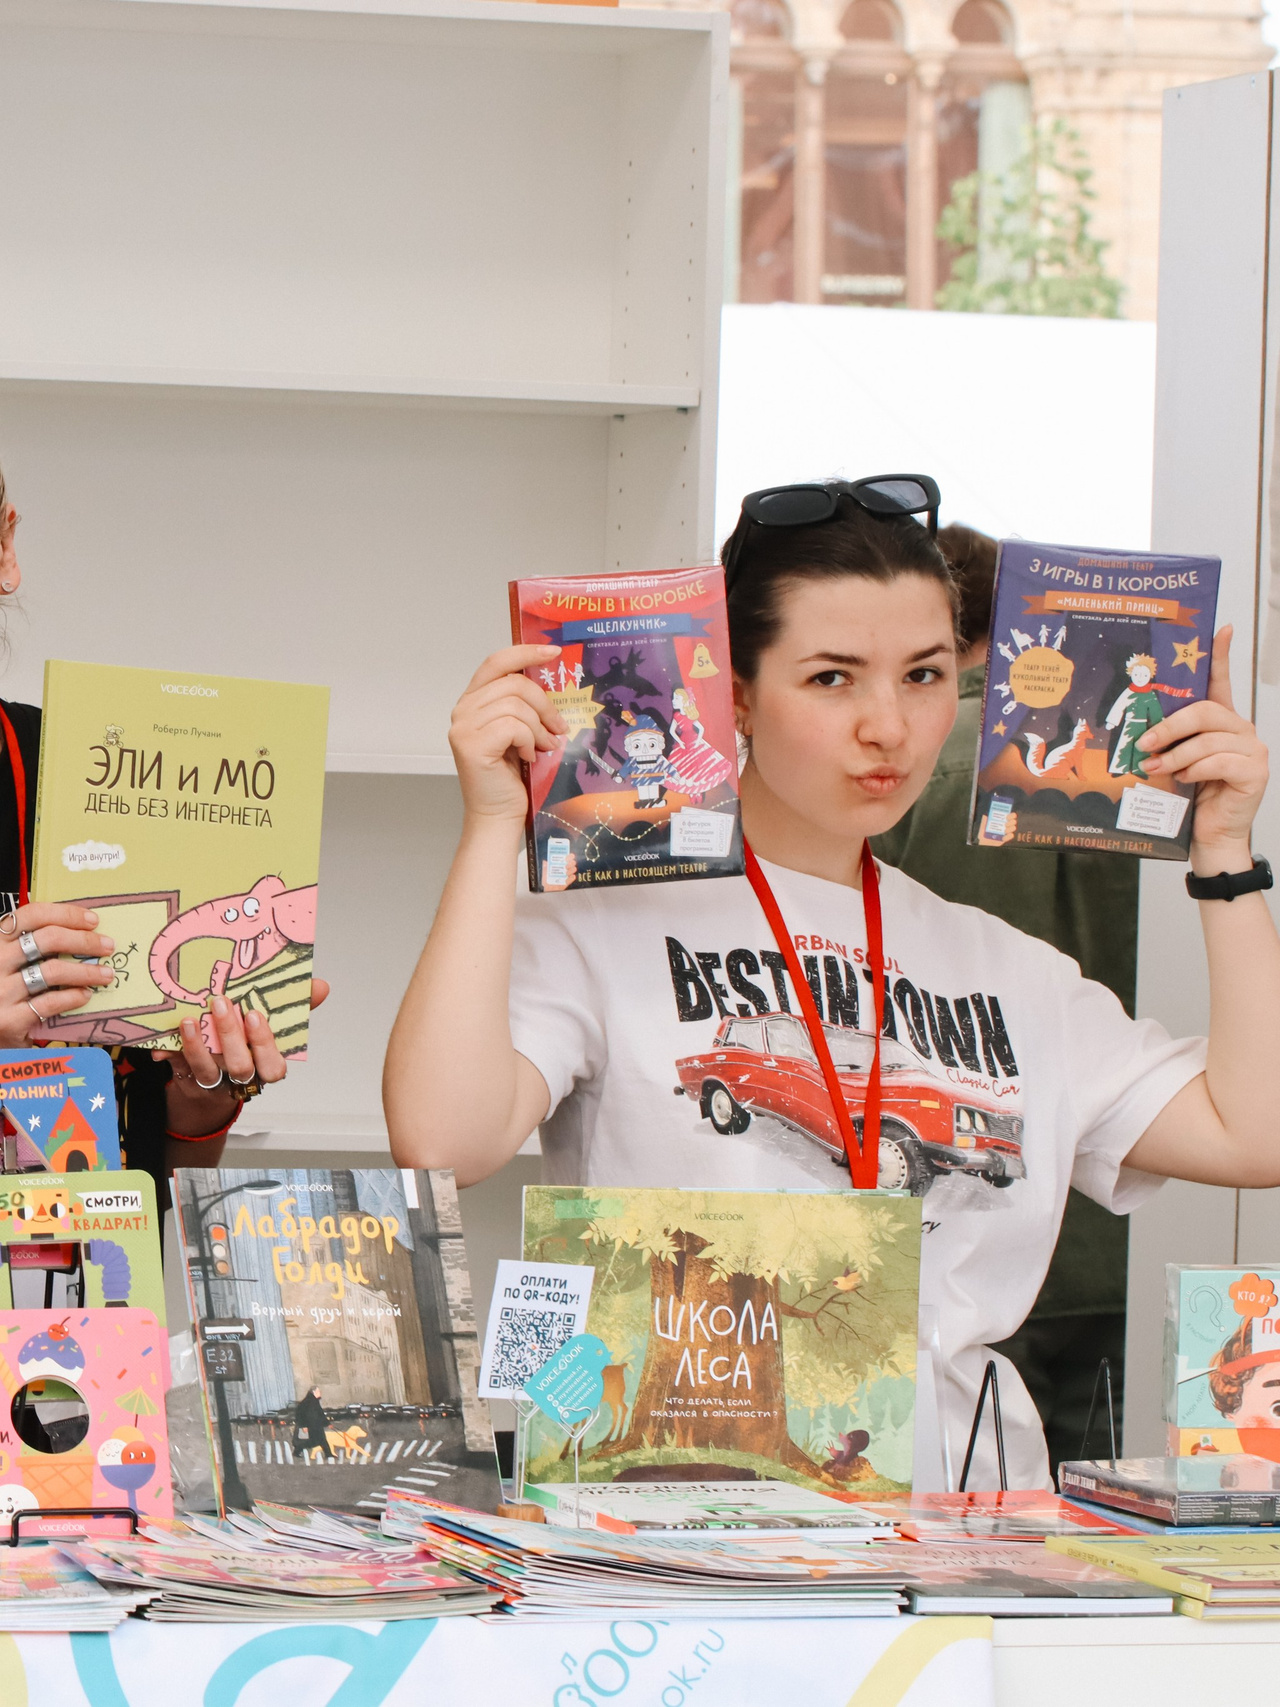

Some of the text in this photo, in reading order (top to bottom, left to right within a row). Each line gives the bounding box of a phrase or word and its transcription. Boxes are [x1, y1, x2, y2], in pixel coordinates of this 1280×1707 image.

[1077, 557, 1154, 571] ДОМАШНИЙ ТЕАТР
[1029, 558, 1200, 592] 3 ИГРЫ В 1 КОРОБКЕ
[586, 577, 661, 592] ДОМАШНИЙ ТЕАТР
[543, 580, 707, 612] 3 ИГРЫ В КОРОБКЕ
[1057, 594, 1164, 615] «МАЛЕНЬКИЙ ПРИНЦ»
[586, 618, 668, 634] «ЩЕЛКУНЧИК»
[587, 638, 648, 648] спектакль для всей
[697, 656, 711, 668] 5+
[1182, 648, 1194, 660] 5+
[1012, 673, 1051, 683] КУКОЛЬНЫЙ
[160, 683, 219, 698] VOICEBOOK
[1023, 684, 1055, 693] РАСКРАСКА
[153, 724, 222, 740] Роберто Лучани
[85, 745, 275, 801] ЭЛИ МО
[84, 793, 272, 828] ДЕНЬ БЕЗ ИНТЕРНЕТА
[1017, 832, 1154, 852] ВСЁ КАК НАСТОЯЩЕМ ТЕАТРЕ
[68, 850, 120, 863] Игра внутри!
[578, 863, 707, 883] ВСЁ КАК НАСТОЯЩЕМ ТЕАТРЕ
[665, 936, 795, 1023] BEST
[1, 1060, 66, 1080] СМОТРИ,
[945, 1067, 990, 1092] Classic
[85, 1194, 142, 1210] СМОТРИ,
[73, 1216, 148, 1231] КВАДРАТ!
[232, 1198, 400, 1254] Лабрадор
[273, 1246, 370, 1299] Голди
[521, 1275, 567, 1289] ОПЛАТИ
[504, 1288, 580, 1305] ПО QR-КОДУ!
[1237, 1291, 1256, 1301] КТО
[251, 1302, 402, 1325] Верный друг и герой
[654, 1296, 779, 1346] ШКОЛА
[206, 1349, 236, 1363] E 32
[674, 1348, 752, 1391] ЛЕСА
[553, 1365, 582, 1395] voicebook.ru
[564, 1376, 594, 1406] voicebook.ru
[665, 1397, 684, 1405] ЧТО
[687, 1397, 725, 1408] ДЕЛАТЬ,
[650, 1410, 697, 1418] ОКАЗАЛСЯ
